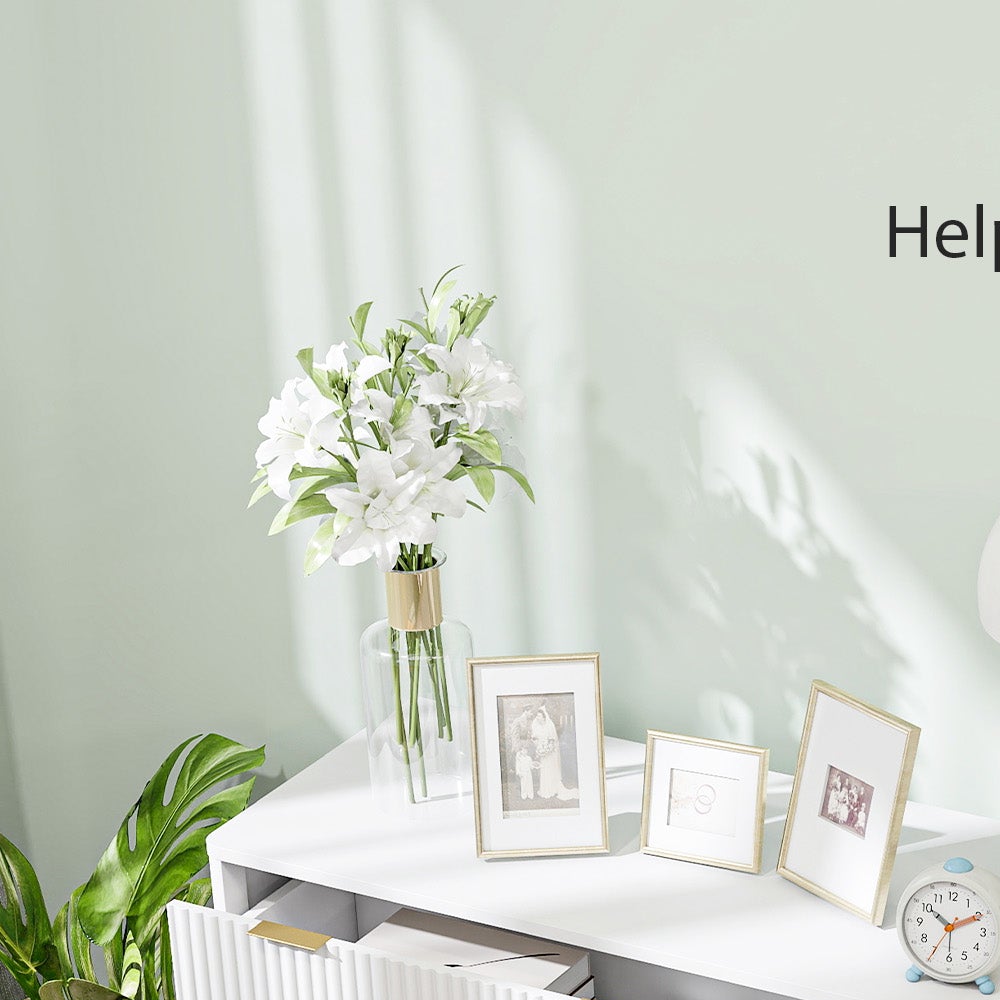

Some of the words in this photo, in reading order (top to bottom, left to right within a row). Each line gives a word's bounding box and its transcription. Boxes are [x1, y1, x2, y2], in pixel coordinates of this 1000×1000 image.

[934, 893, 943, 904] 11
[948, 891, 959, 902] 12
[922, 903, 934, 913] 10
[916, 917, 924, 927] 9
[980, 927, 987, 937] 3
[920, 933, 928, 943] 8
[973, 942, 980, 951] 4
[945, 953, 953, 963] 6
[961, 951, 968, 961] 5
